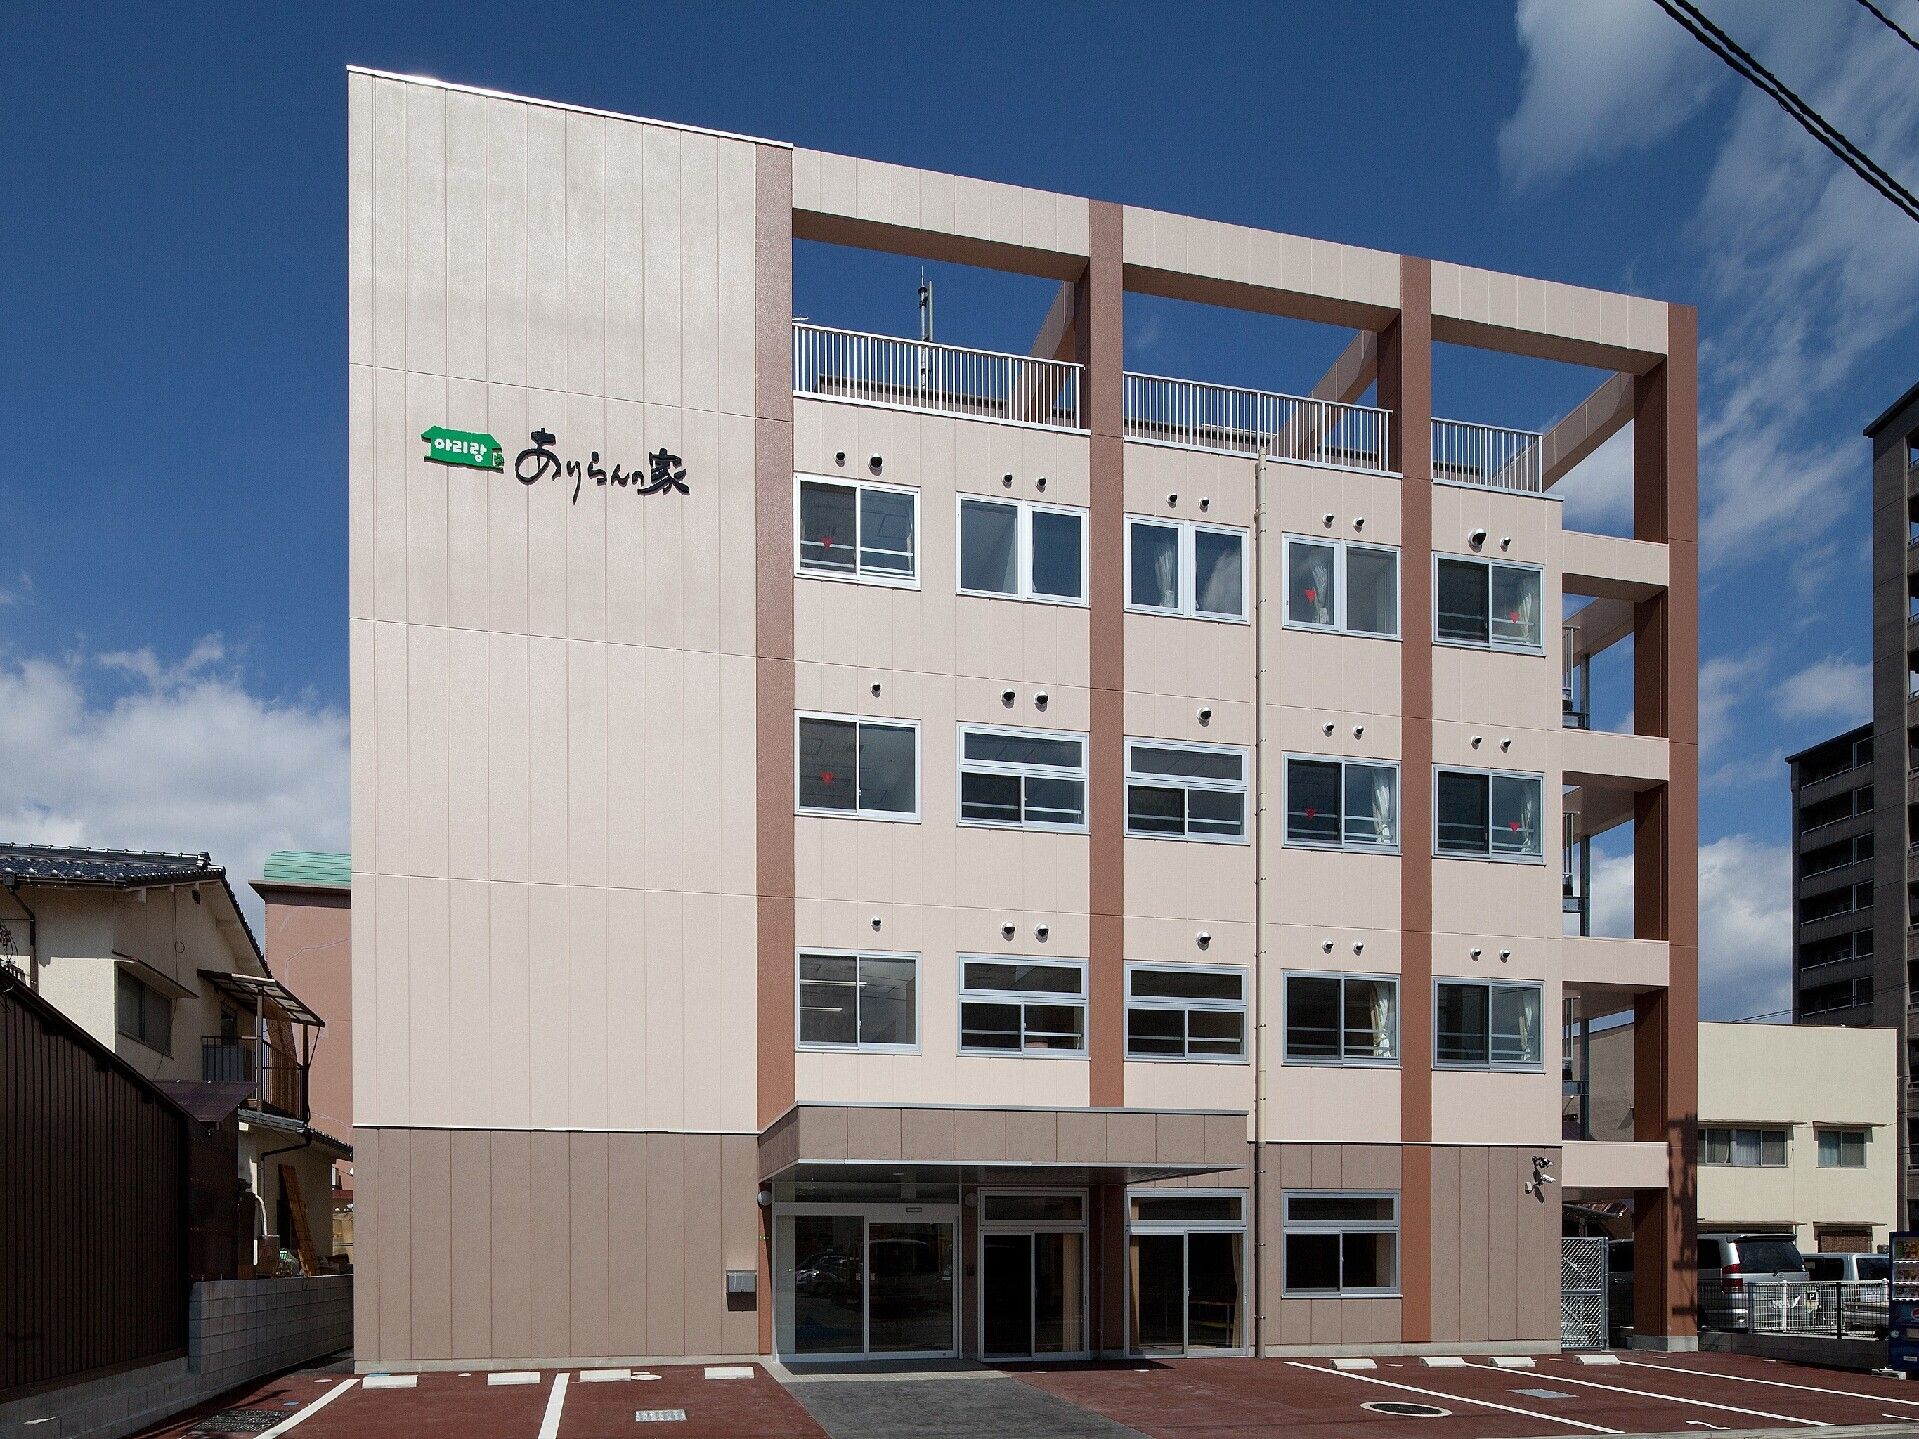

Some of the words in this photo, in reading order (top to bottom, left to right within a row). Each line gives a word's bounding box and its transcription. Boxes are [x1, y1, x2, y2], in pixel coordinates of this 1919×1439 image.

[434, 438, 487, 462] 아리랑
[515, 427, 690, 504] ありらんの家
